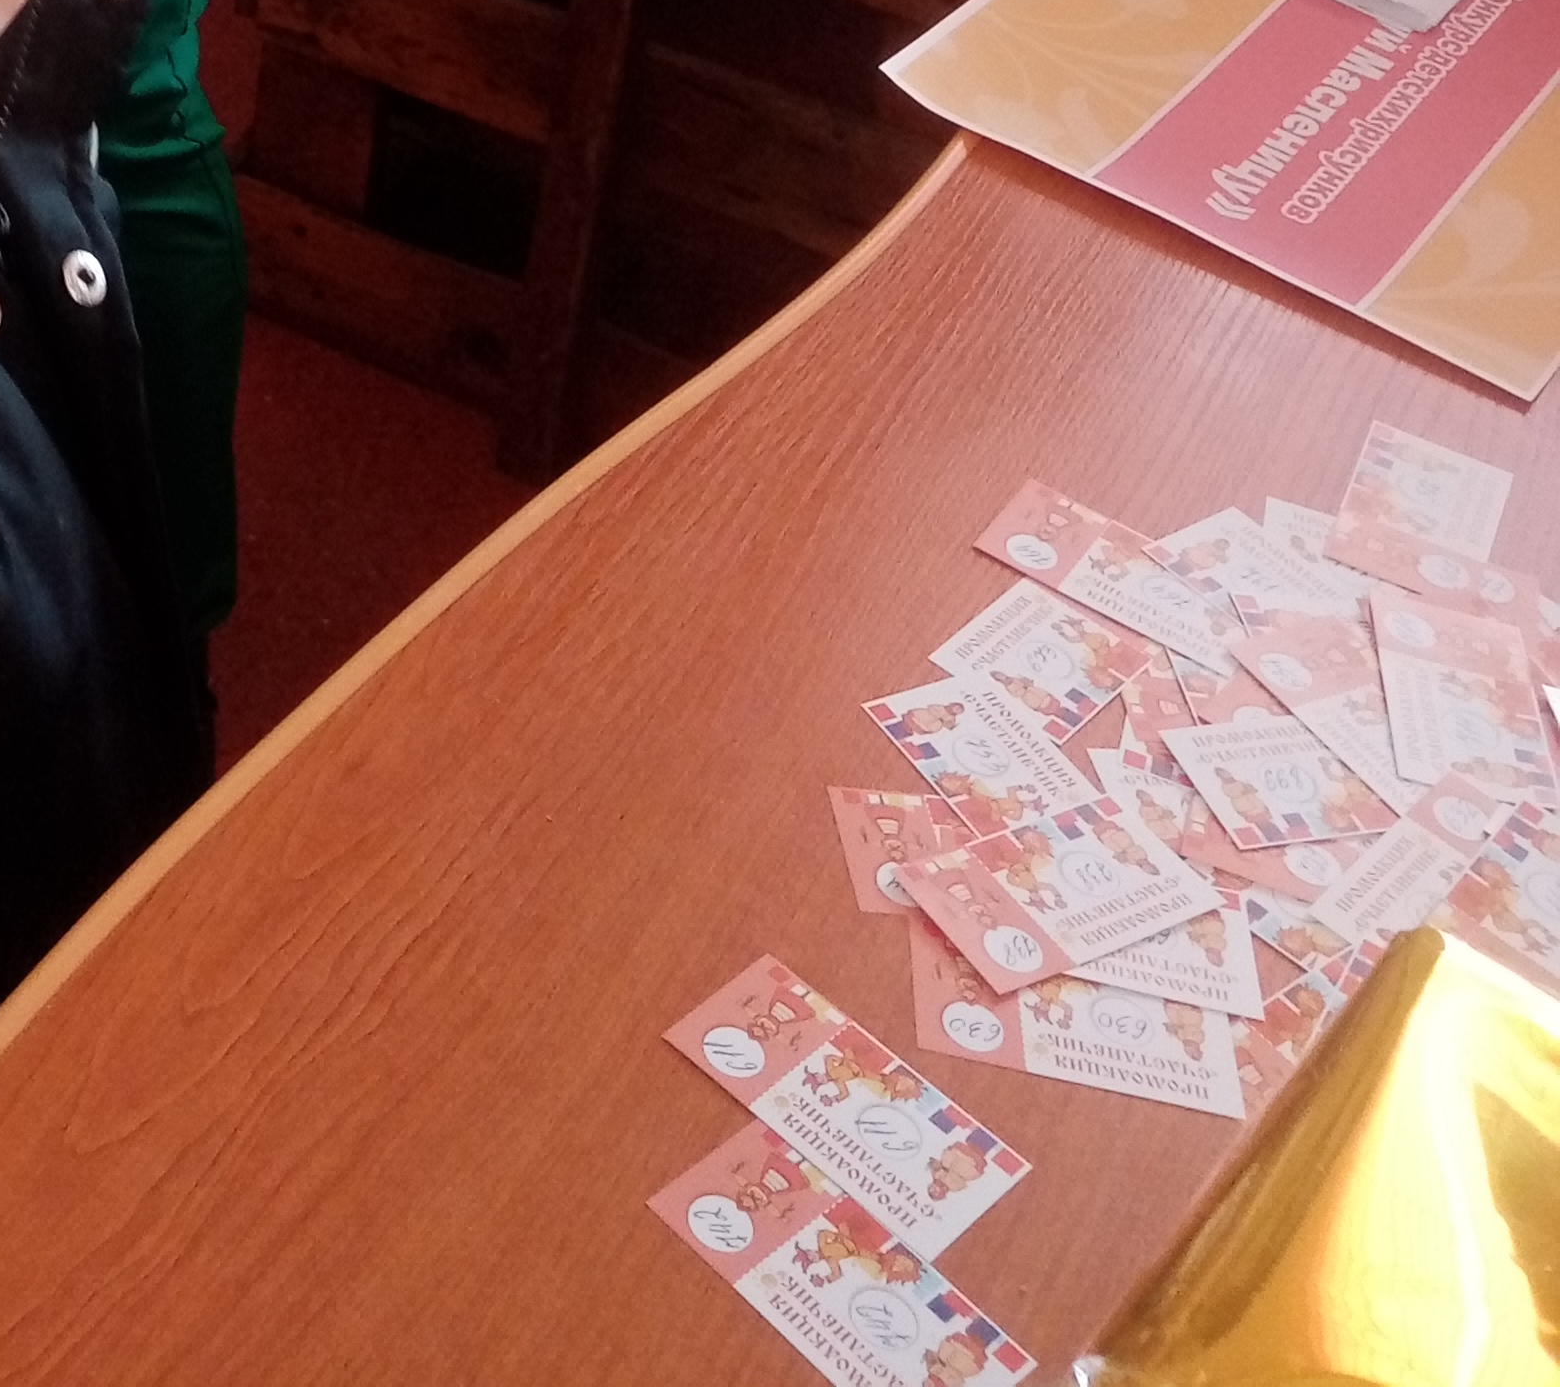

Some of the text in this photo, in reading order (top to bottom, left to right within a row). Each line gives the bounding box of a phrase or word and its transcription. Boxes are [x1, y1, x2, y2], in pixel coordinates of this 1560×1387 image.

[1365, 45, 1457, 132] детских
[1205, 44, 1395, 220] Масленицу»
[1280, 118, 1392, 224] рисунков
[954, 594, 1033, 660] ПРОМОАКЦИЯ
[981, 690, 1077, 788] ПРОМОАКЦИЯ
[1335, 835, 1416, 913] ПРОМОАКЦИЯ
[1080, 892, 1193, 947] ПРОМОАКЦИЯ
[1004, 934, 1038, 968] 738
[948, 1017, 1001, 1042] 630
[1097, 1011, 1148, 1041] 630
[702, 1040, 759, 1072] 611
[1054, 1053, 1210, 1100] ПРОМОАКЦИЯ
[855, 1119, 920, 1152] 611
[781, 1112, 919, 1230] ПРОМОАКЦИЯ
[693, 1205, 749, 1250] 742
[768, 1293, 872, 1387] МОАКЦИЯ
[855, 1304, 912, 1347] 742
